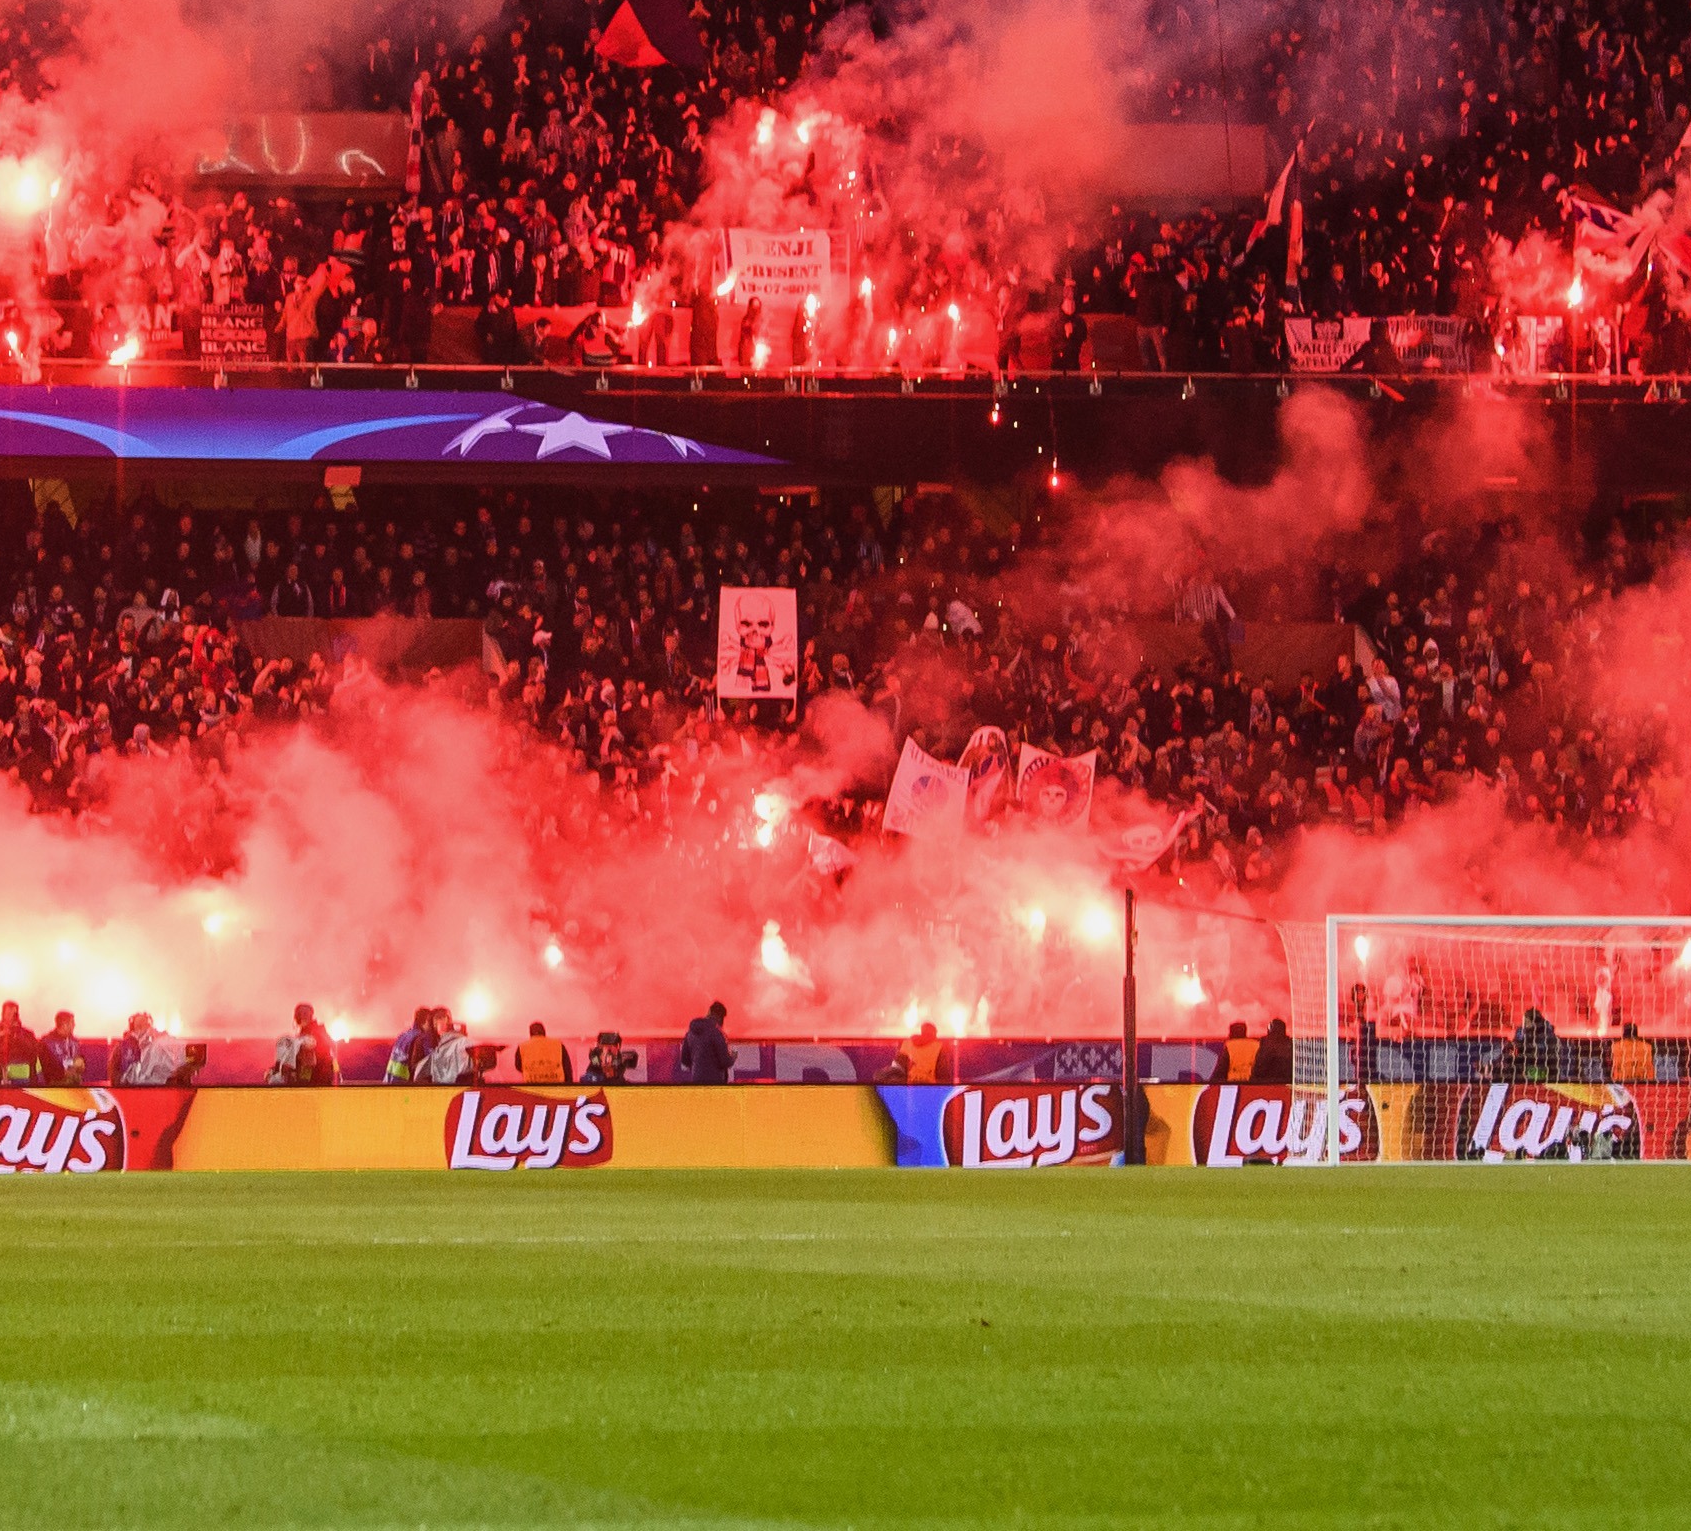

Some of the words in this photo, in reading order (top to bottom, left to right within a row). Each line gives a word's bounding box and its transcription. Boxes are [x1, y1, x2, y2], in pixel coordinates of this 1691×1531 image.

[201, 316, 264, 328] BLANC
[201, 341, 266, 354] BLANC
[451, 1091, 606, 1171] Lay's
[962, 1085, 1112, 1168] Lay's
